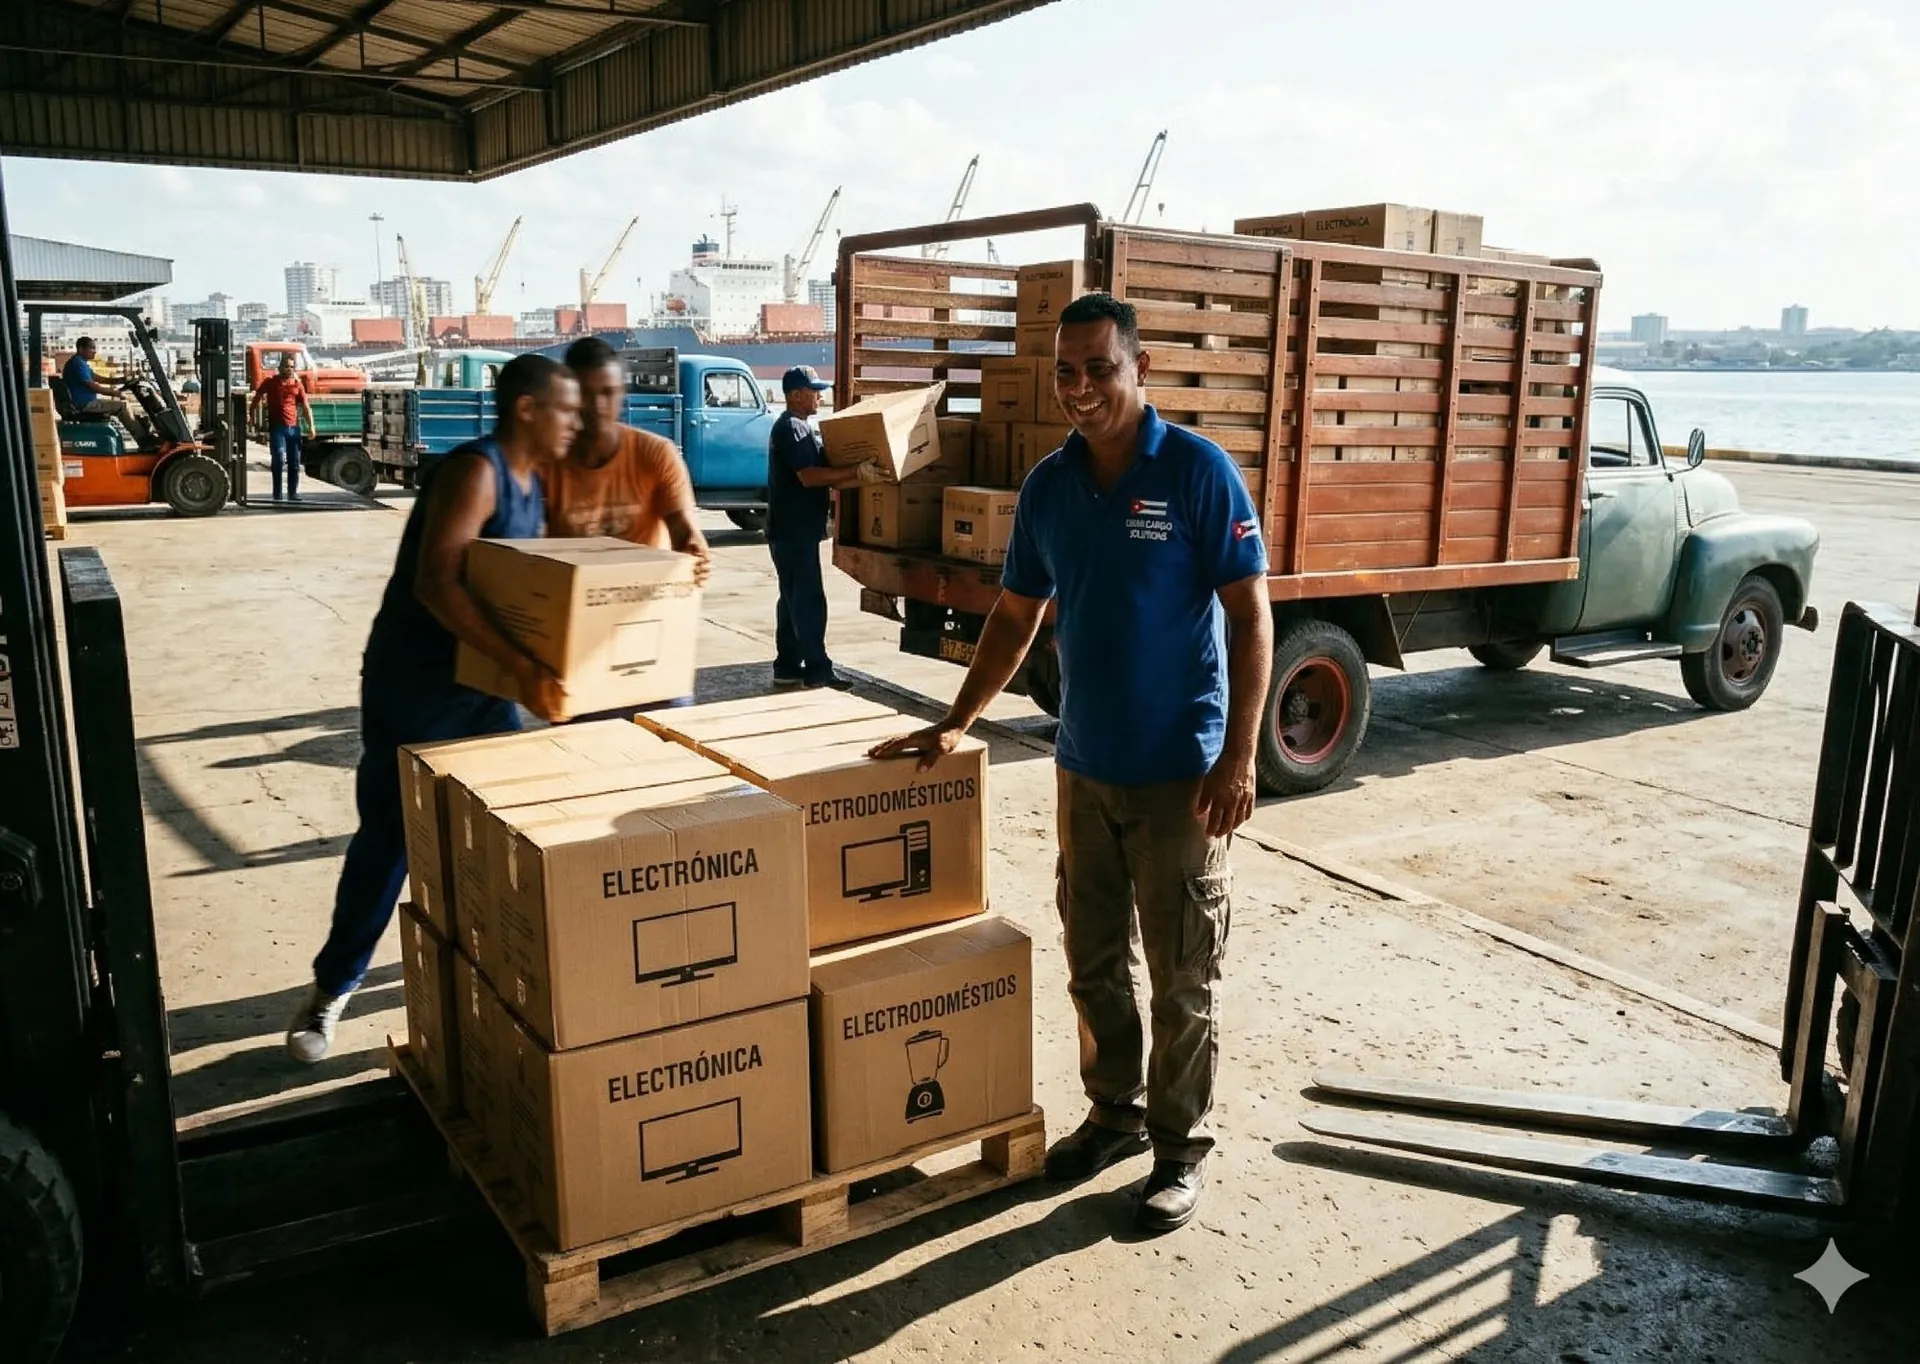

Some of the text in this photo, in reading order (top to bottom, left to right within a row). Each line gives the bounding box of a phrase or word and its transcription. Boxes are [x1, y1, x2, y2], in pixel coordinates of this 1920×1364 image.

[805, 777, 976, 827] ECTRODOMÉSTICOS
[602, 848, 760, 899] ELECTRÓNICA
[843, 973, 1017, 1041] ELECTRODOMÉSTIOS
[608, 1044, 763, 1104] ELECTRÓNICA
